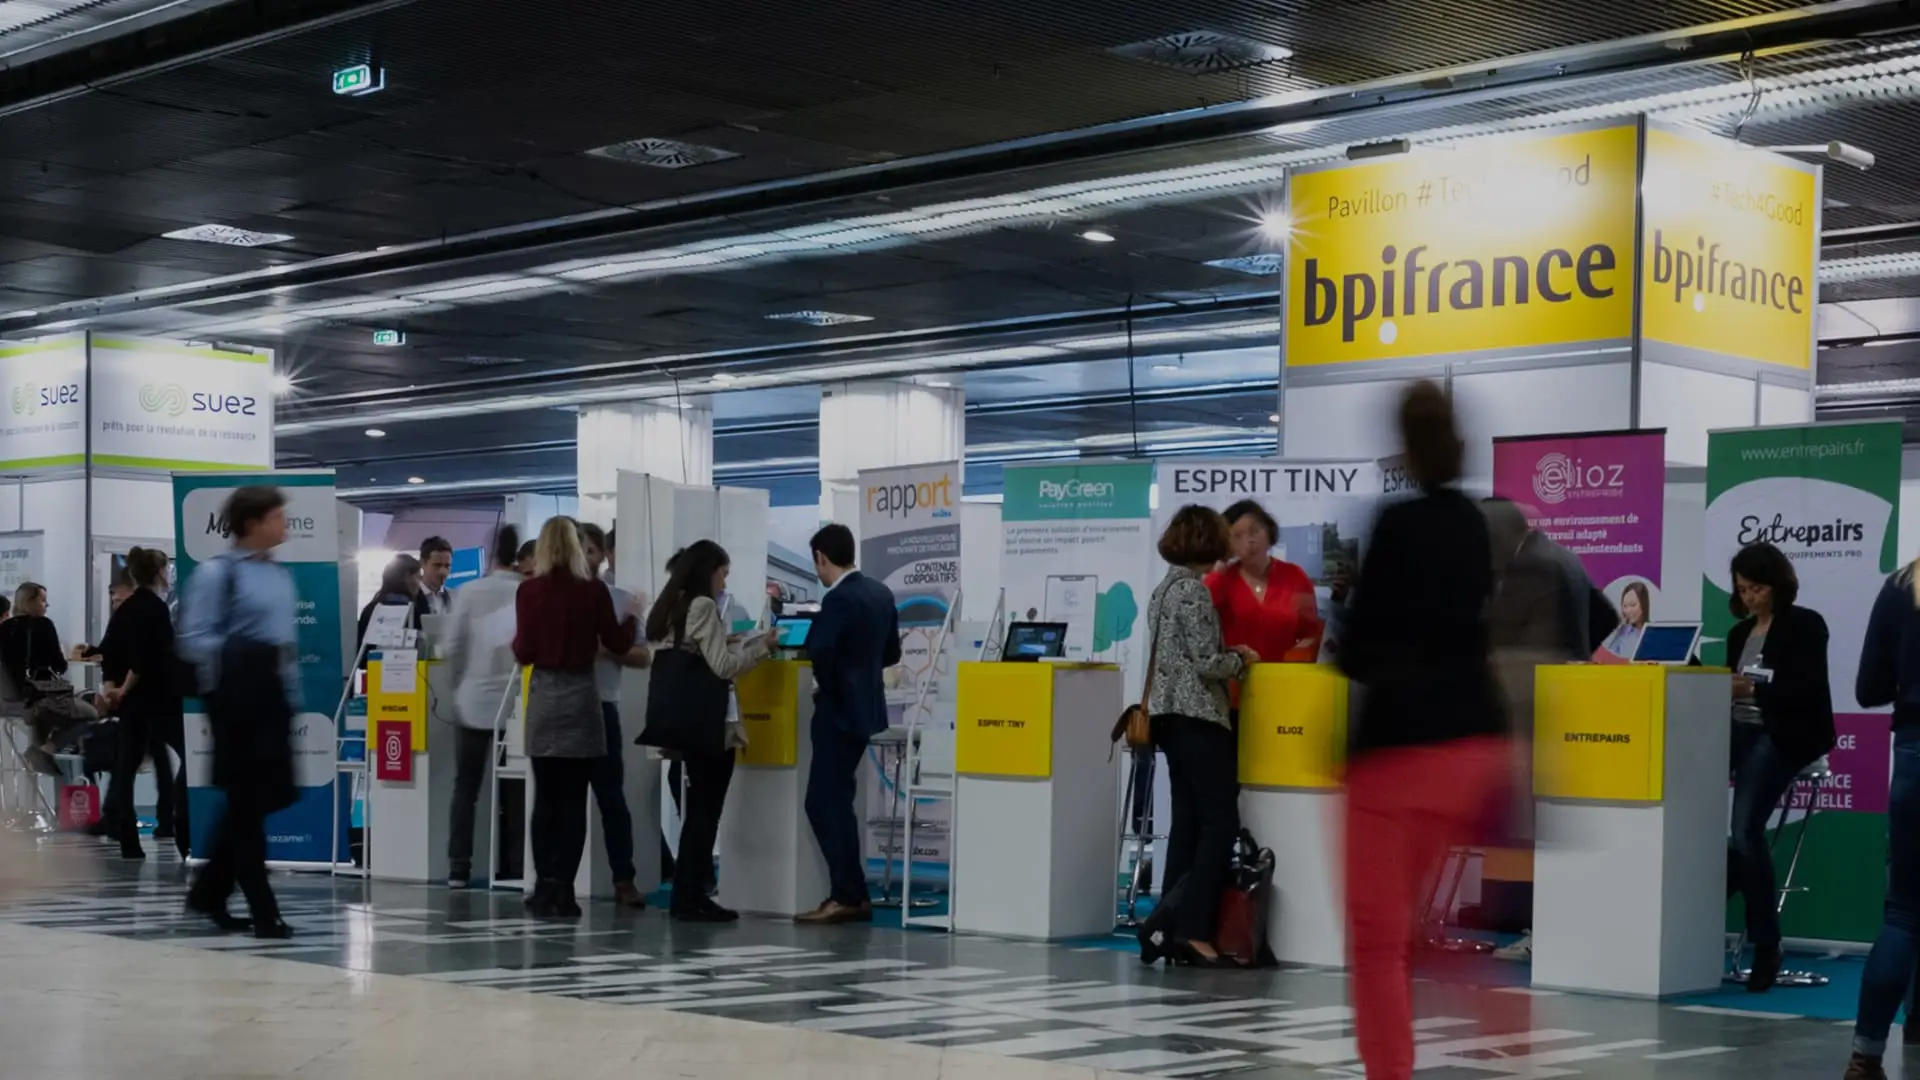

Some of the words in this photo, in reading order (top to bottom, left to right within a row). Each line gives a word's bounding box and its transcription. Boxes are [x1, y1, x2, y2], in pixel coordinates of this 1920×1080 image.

[1328, 186, 1408, 220] Pavillon
[1653, 229, 1804, 315] bpifrance
[1304, 244, 1617, 343] bpifrance
[41, 384, 80, 407] suez
[192, 392, 257, 416] suez
[1741, 437, 1864, 461] www.entrepairs.fr
[1039, 479, 1115, 501] PayGreen
[1175, 468, 1278, 494] ESPRIT
[1284, 468, 1359, 494] TINY
[866, 472, 953, 520] rapport
[1627, 513, 1639, 524] de
[1737, 513, 1864, 547] Entrepairs
[915, 561, 957, 573] CONTENUS
[903, 573, 957, 585] CORPORATIFS
[978, 718, 1004, 727] ESPRIT
[1277, 726, 1303, 735] ELIOZ
[1564, 732, 1631, 743] ENTREPAIRS
